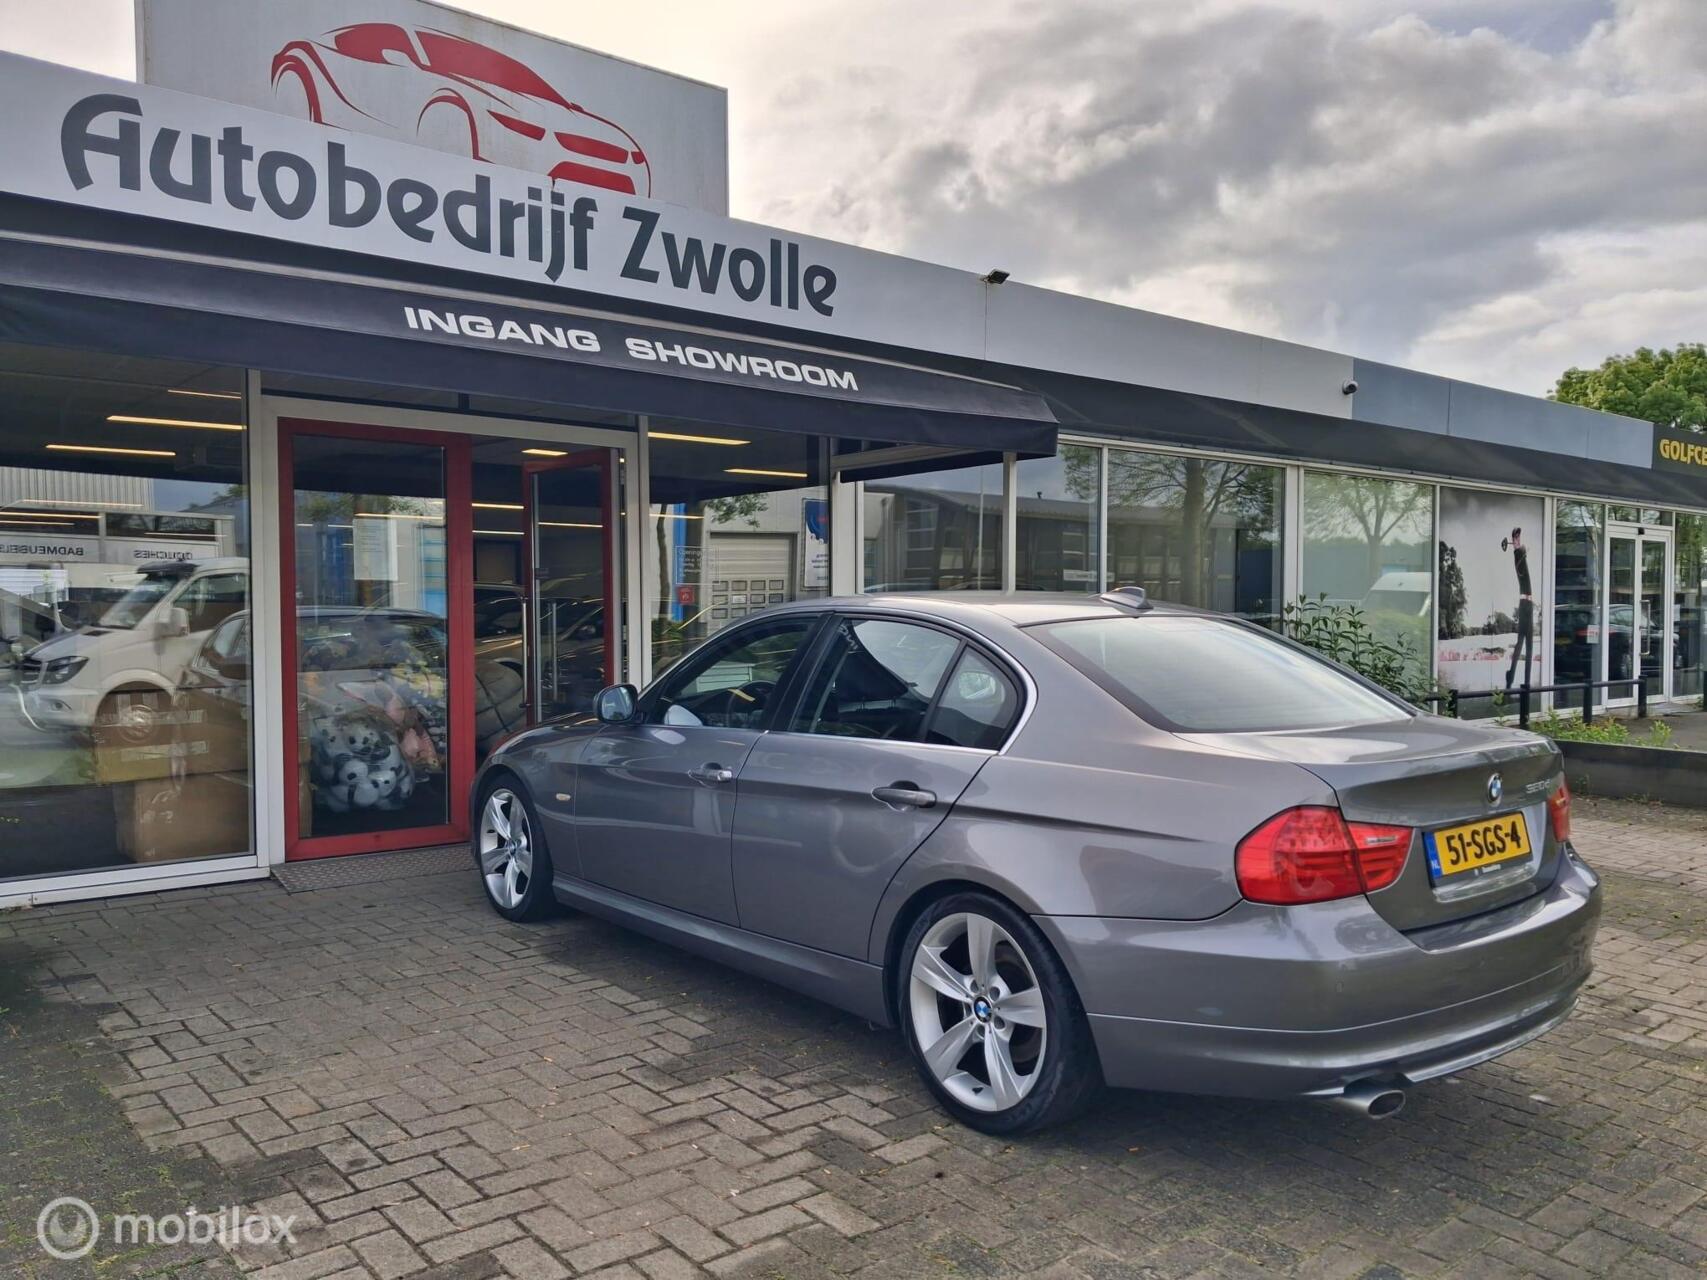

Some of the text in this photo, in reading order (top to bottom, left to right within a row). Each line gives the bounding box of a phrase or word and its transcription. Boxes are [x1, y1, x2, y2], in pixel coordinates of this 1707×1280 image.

[61, 93, 837, 317] Autobedrijf Zwolle
[404, 306, 859, 391] INGANG SHOWROOM
[1445, 821, 1522, 866] 51-SGS-4
